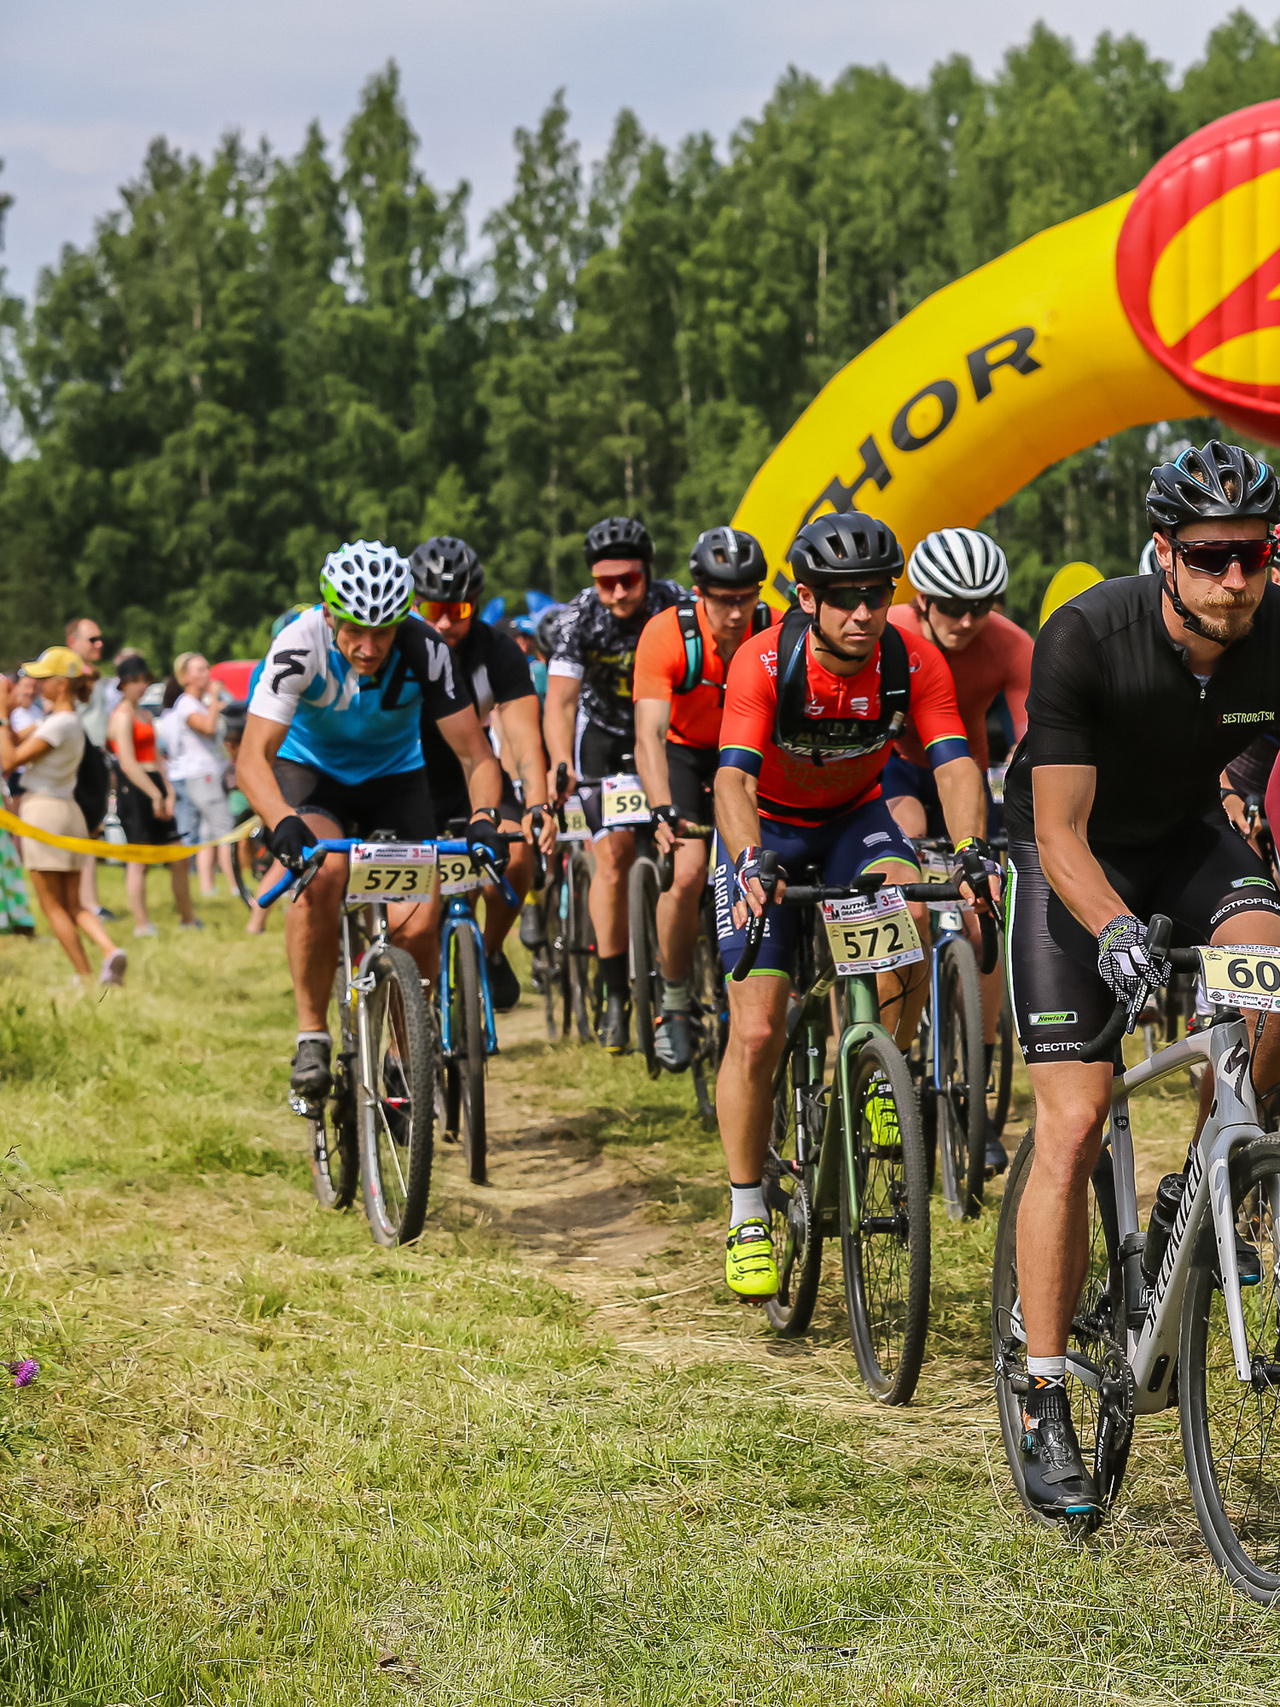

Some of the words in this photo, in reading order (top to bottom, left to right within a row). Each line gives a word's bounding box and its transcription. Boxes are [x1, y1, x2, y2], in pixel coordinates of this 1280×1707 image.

[775, 326, 1043, 590] THOR
[616, 794, 642, 813] 59
[364, 869, 418, 891] 573
[714, 863, 734, 941] BAHRAIN
[841, 900, 870, 910] AUTHO
[843, 922, 904, 959] 572
[1035, 1042, 1084, 1053] СЕСТРО
